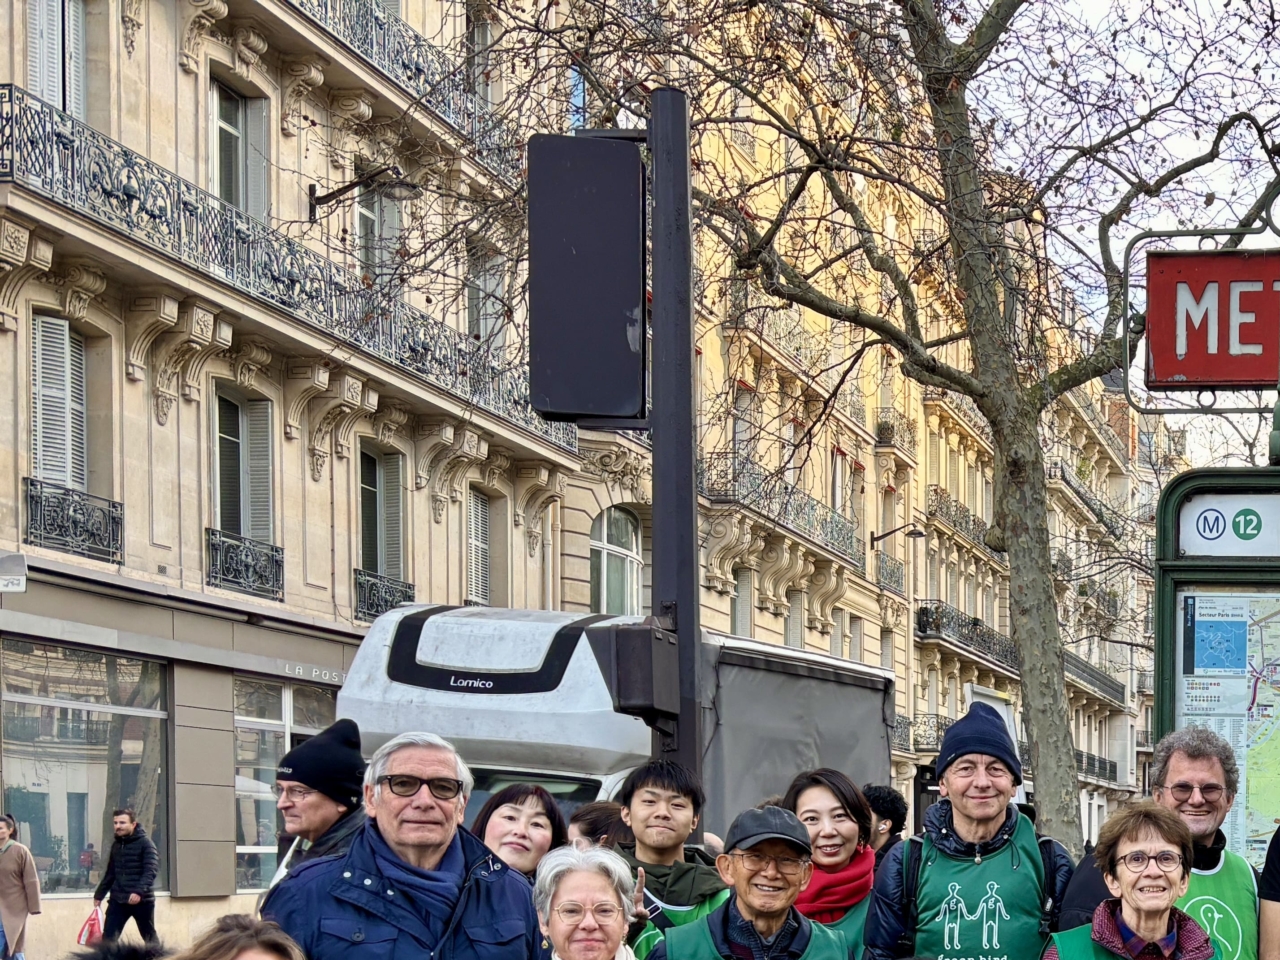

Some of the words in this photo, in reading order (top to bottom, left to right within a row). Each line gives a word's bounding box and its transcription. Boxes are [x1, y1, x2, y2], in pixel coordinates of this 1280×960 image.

[1235, 514, 1258, 534] 12
[285, 663, 303, 676] LA
[450, 675, 493, 688] Lamico
